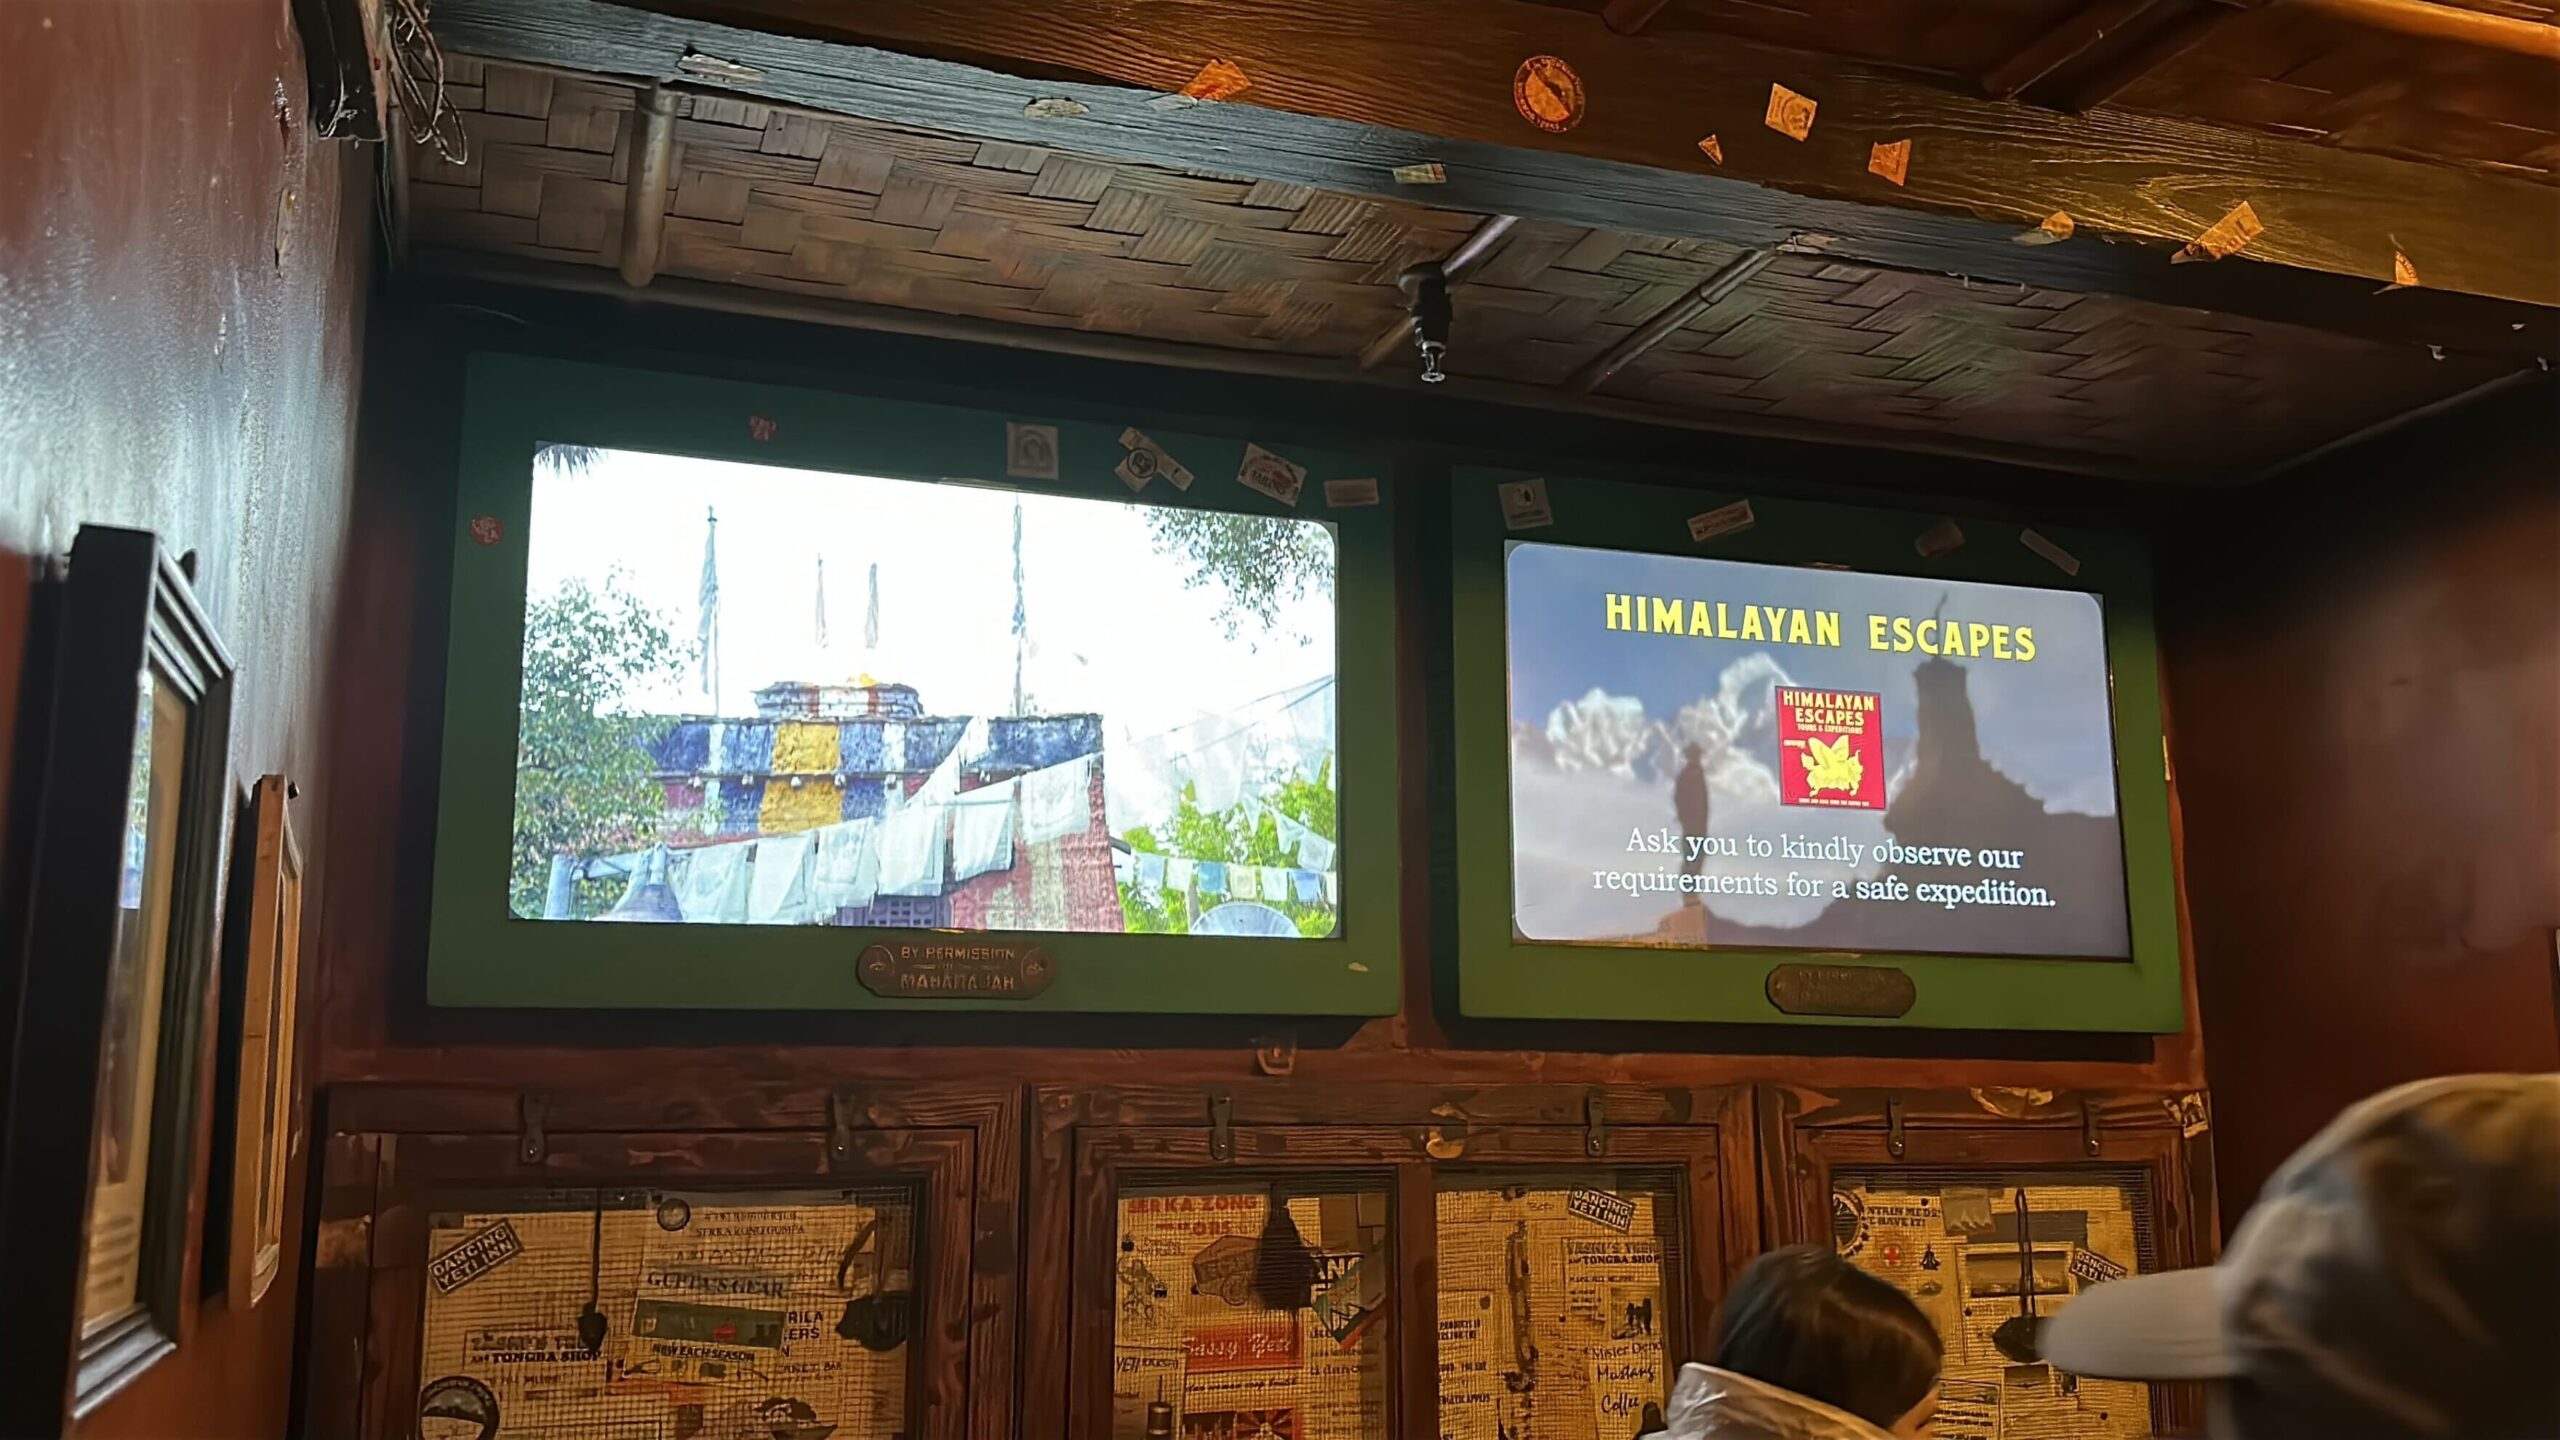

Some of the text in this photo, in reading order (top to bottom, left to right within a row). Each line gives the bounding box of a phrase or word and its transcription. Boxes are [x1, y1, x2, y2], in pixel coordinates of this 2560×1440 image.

[1605, 593, 2037, 662] HIMALAYAN ESCAPES
[1783, 690, 1875, 711] HIMALAYAN
[1795, 708, 1865, 726] ESCAPES
[1797, 723, 1817, 732] TOURS
[1824, 724, 1863, 735] EXPEDITIONS
[1626, 826, 2024, 869] Ask you to kindly observe our
[1593, 866, 2056, 909] requirements for a safe expedition.
[901, 945, 1015, 960] BY PERMISSION
[1200, 1196, 1258, 1211] ZONG
[1572, 1200, 1601, 1217] YETI
[433, 1229, 507, 1276] DANCING
[1583, 1256, 1629, 1265] TONGBA
[1632, 1254, 1661, 1264] SHOP
[440, 1240, 514, 1286] YETI INN
[492, 1352, 558, 1364] TONGBA
[560, 1349, 603, 1362] SHOP
[680, 1345, 711, 1358] EACH
[712, 1347, 756, 1362] SEASON
